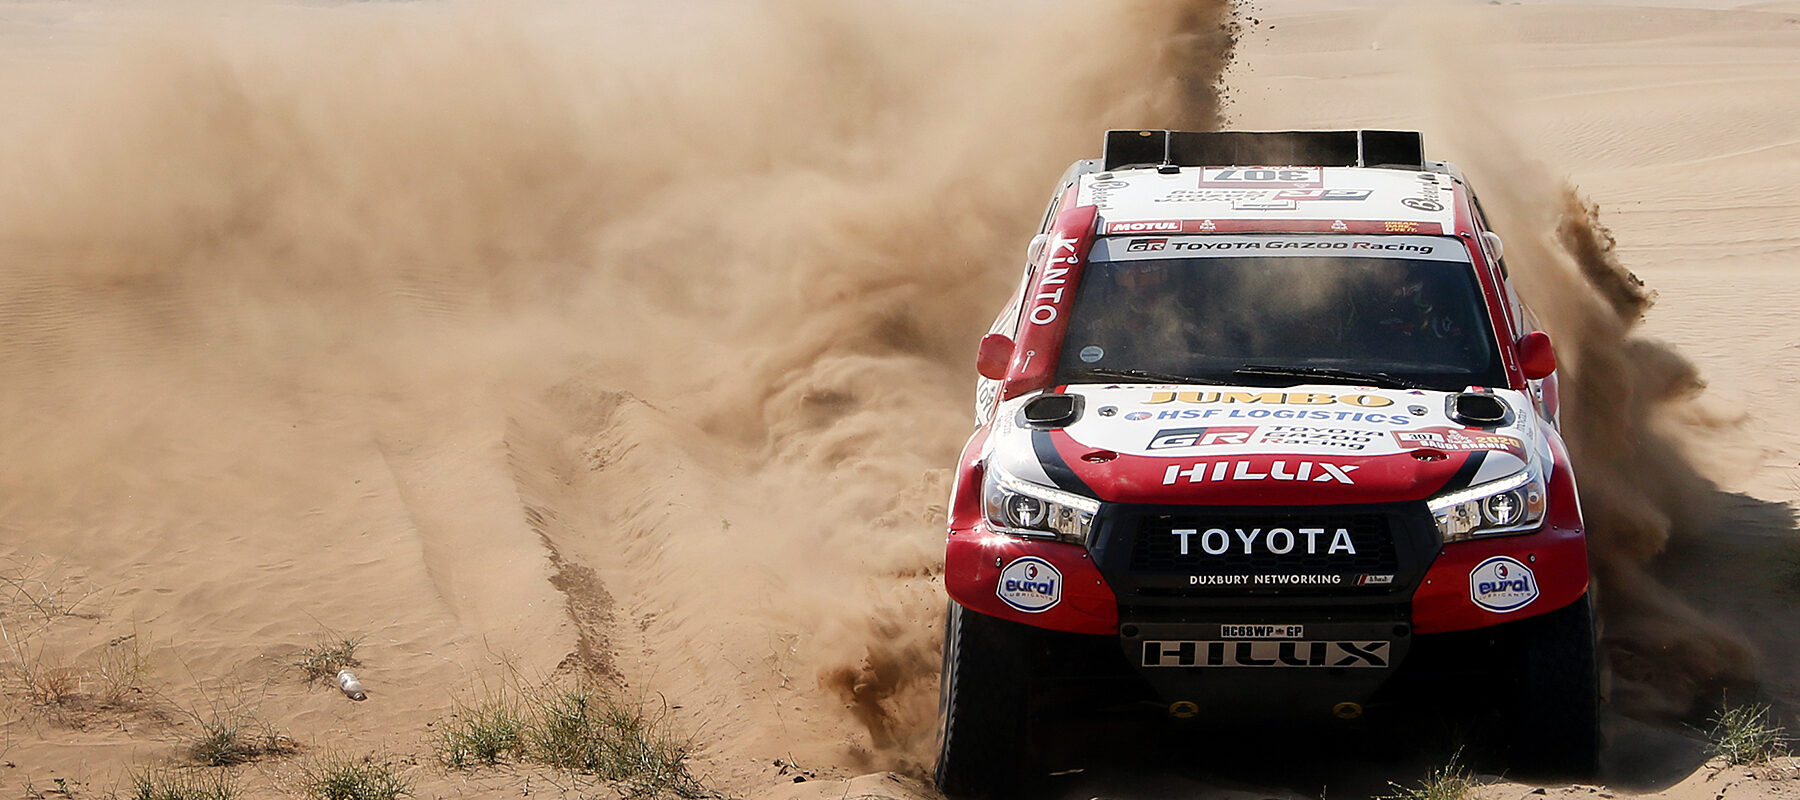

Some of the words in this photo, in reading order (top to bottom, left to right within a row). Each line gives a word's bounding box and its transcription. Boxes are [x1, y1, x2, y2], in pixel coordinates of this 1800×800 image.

[1112, 222, 1178, 232] MOTUL
[1128, 239, 1167, 252] GR
[1171, 241, 1261, 250] TOYOTA
[1265, 241, 1349, 250] GAZOO
[1352, 241, 1434, 255] Racing
[1140, 391, 1395, 408] JUMBO
[1156, 409, 1223, 420] HSF
[1228, 409, 1411, 425] LOGISTICS
[1264, 432, 1371, 442] GAZOO
[1269, 425, 1384, 437] TOYOTA
[1149, 429, 1254, 449] GR
[1260, 438, 1365, 450] Racing
[1420, 440, 1459, 449] SAUDI
[1461, 441, 1510, 450] ARABIA
[1475, 436, 1521, 448] 2020
[1161, 460, 1360, 486] HILUX
[1171, 528, 1357, 555] TOYOTA
[1190, 574, 1250, 585] DUXBURY
[1254, 574, 1341, 584] NETWORKING
[1478, 575, 1531, 595] eurol
[1005, 579, 1055, 596] eurol
[1004, 593, 1054, 601] LUBRICANTS
[1222, 626, 1274, 637] HC68WP
[1286, 626, 1302, 637] GP
[1143, 641, 1388, 666] HILUX
